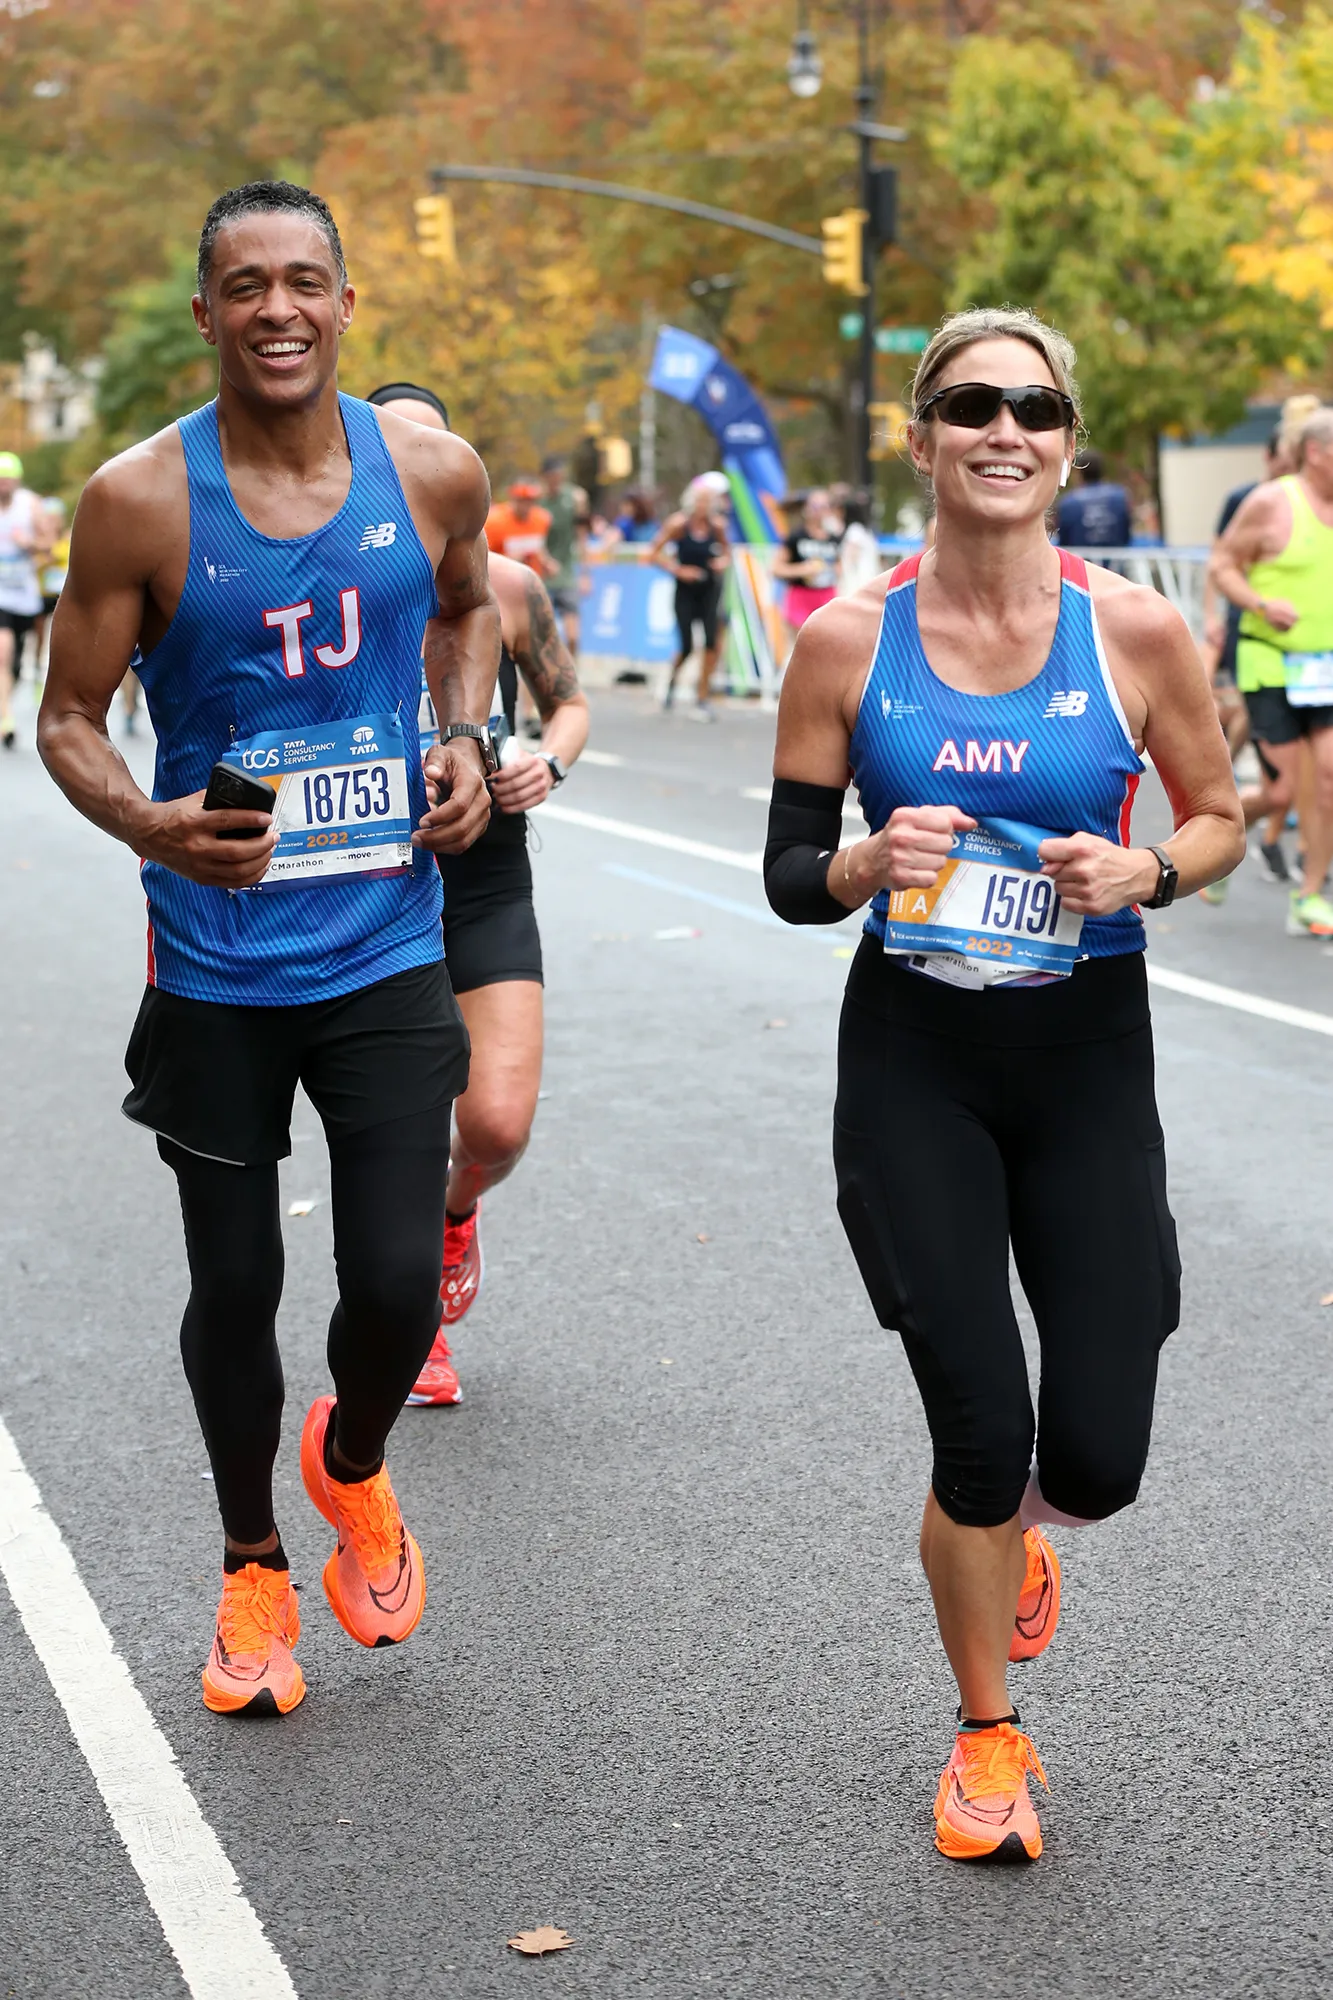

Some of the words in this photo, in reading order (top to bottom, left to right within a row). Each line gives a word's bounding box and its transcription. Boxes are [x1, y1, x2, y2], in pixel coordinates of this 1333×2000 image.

[262, 586, 362, 679] TJ
[283, 740, 306, 749] TATA
[283, 742, 336, 758] CONSULTANCY
[350, 743, 379, 756] TATA
[283, 754, 317, 766] SERVICES
[932, 739, 1030, 773] AMY
[303, 766, 390, 825] 18753
[306, 832, 348, 848] 2022
[972, 828, 990, 836] ATA
[963, 842, 1002, 856] SERVICES
[965, 833, 1022, 852] CONSULTANCY
[348, 851, 372, 860] move
[911, 894, 928, 914] A
[981, 874, 1062, 937] 15191
[964, 936, 1013, 957] 2022
